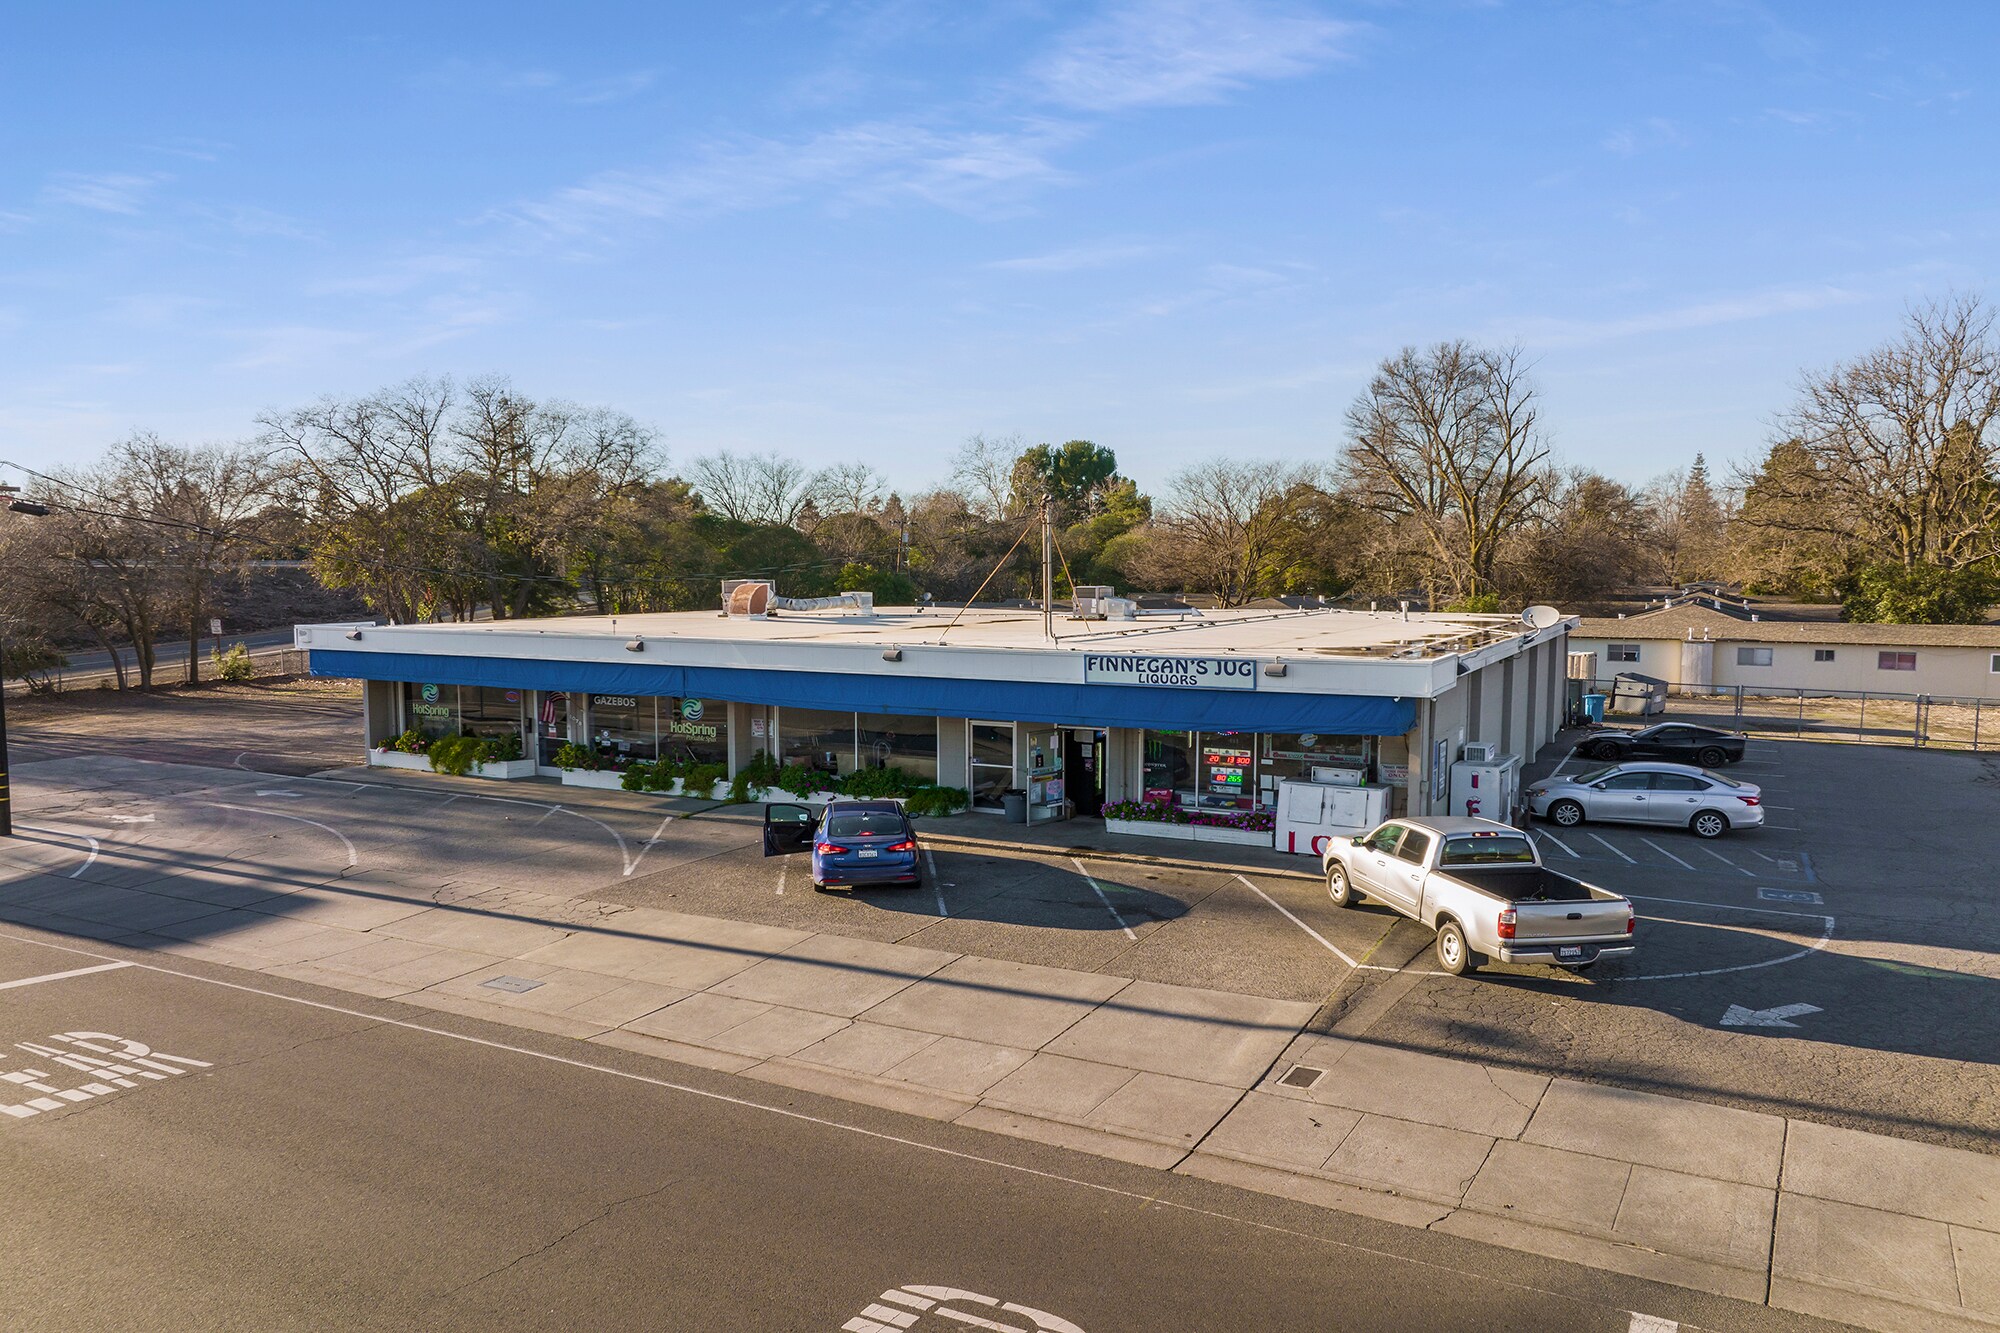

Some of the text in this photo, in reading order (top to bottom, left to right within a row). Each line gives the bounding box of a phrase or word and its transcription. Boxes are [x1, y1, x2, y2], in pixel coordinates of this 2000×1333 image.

[1088, 657, 1252, 677] FINNEGAN'S JUG
[1138, 673, 1198, 685] LIQUORS
[593, 695, 636, 707] GAZEBOS
[412, 703, 449, 718] HotSpring
[670, 721, 717, 738] HotSpring
[1209, 755, 1220, 763] 20
[1236, 757, 1251, 765] 300
[1216, 774, 1242, 783] 80 265
